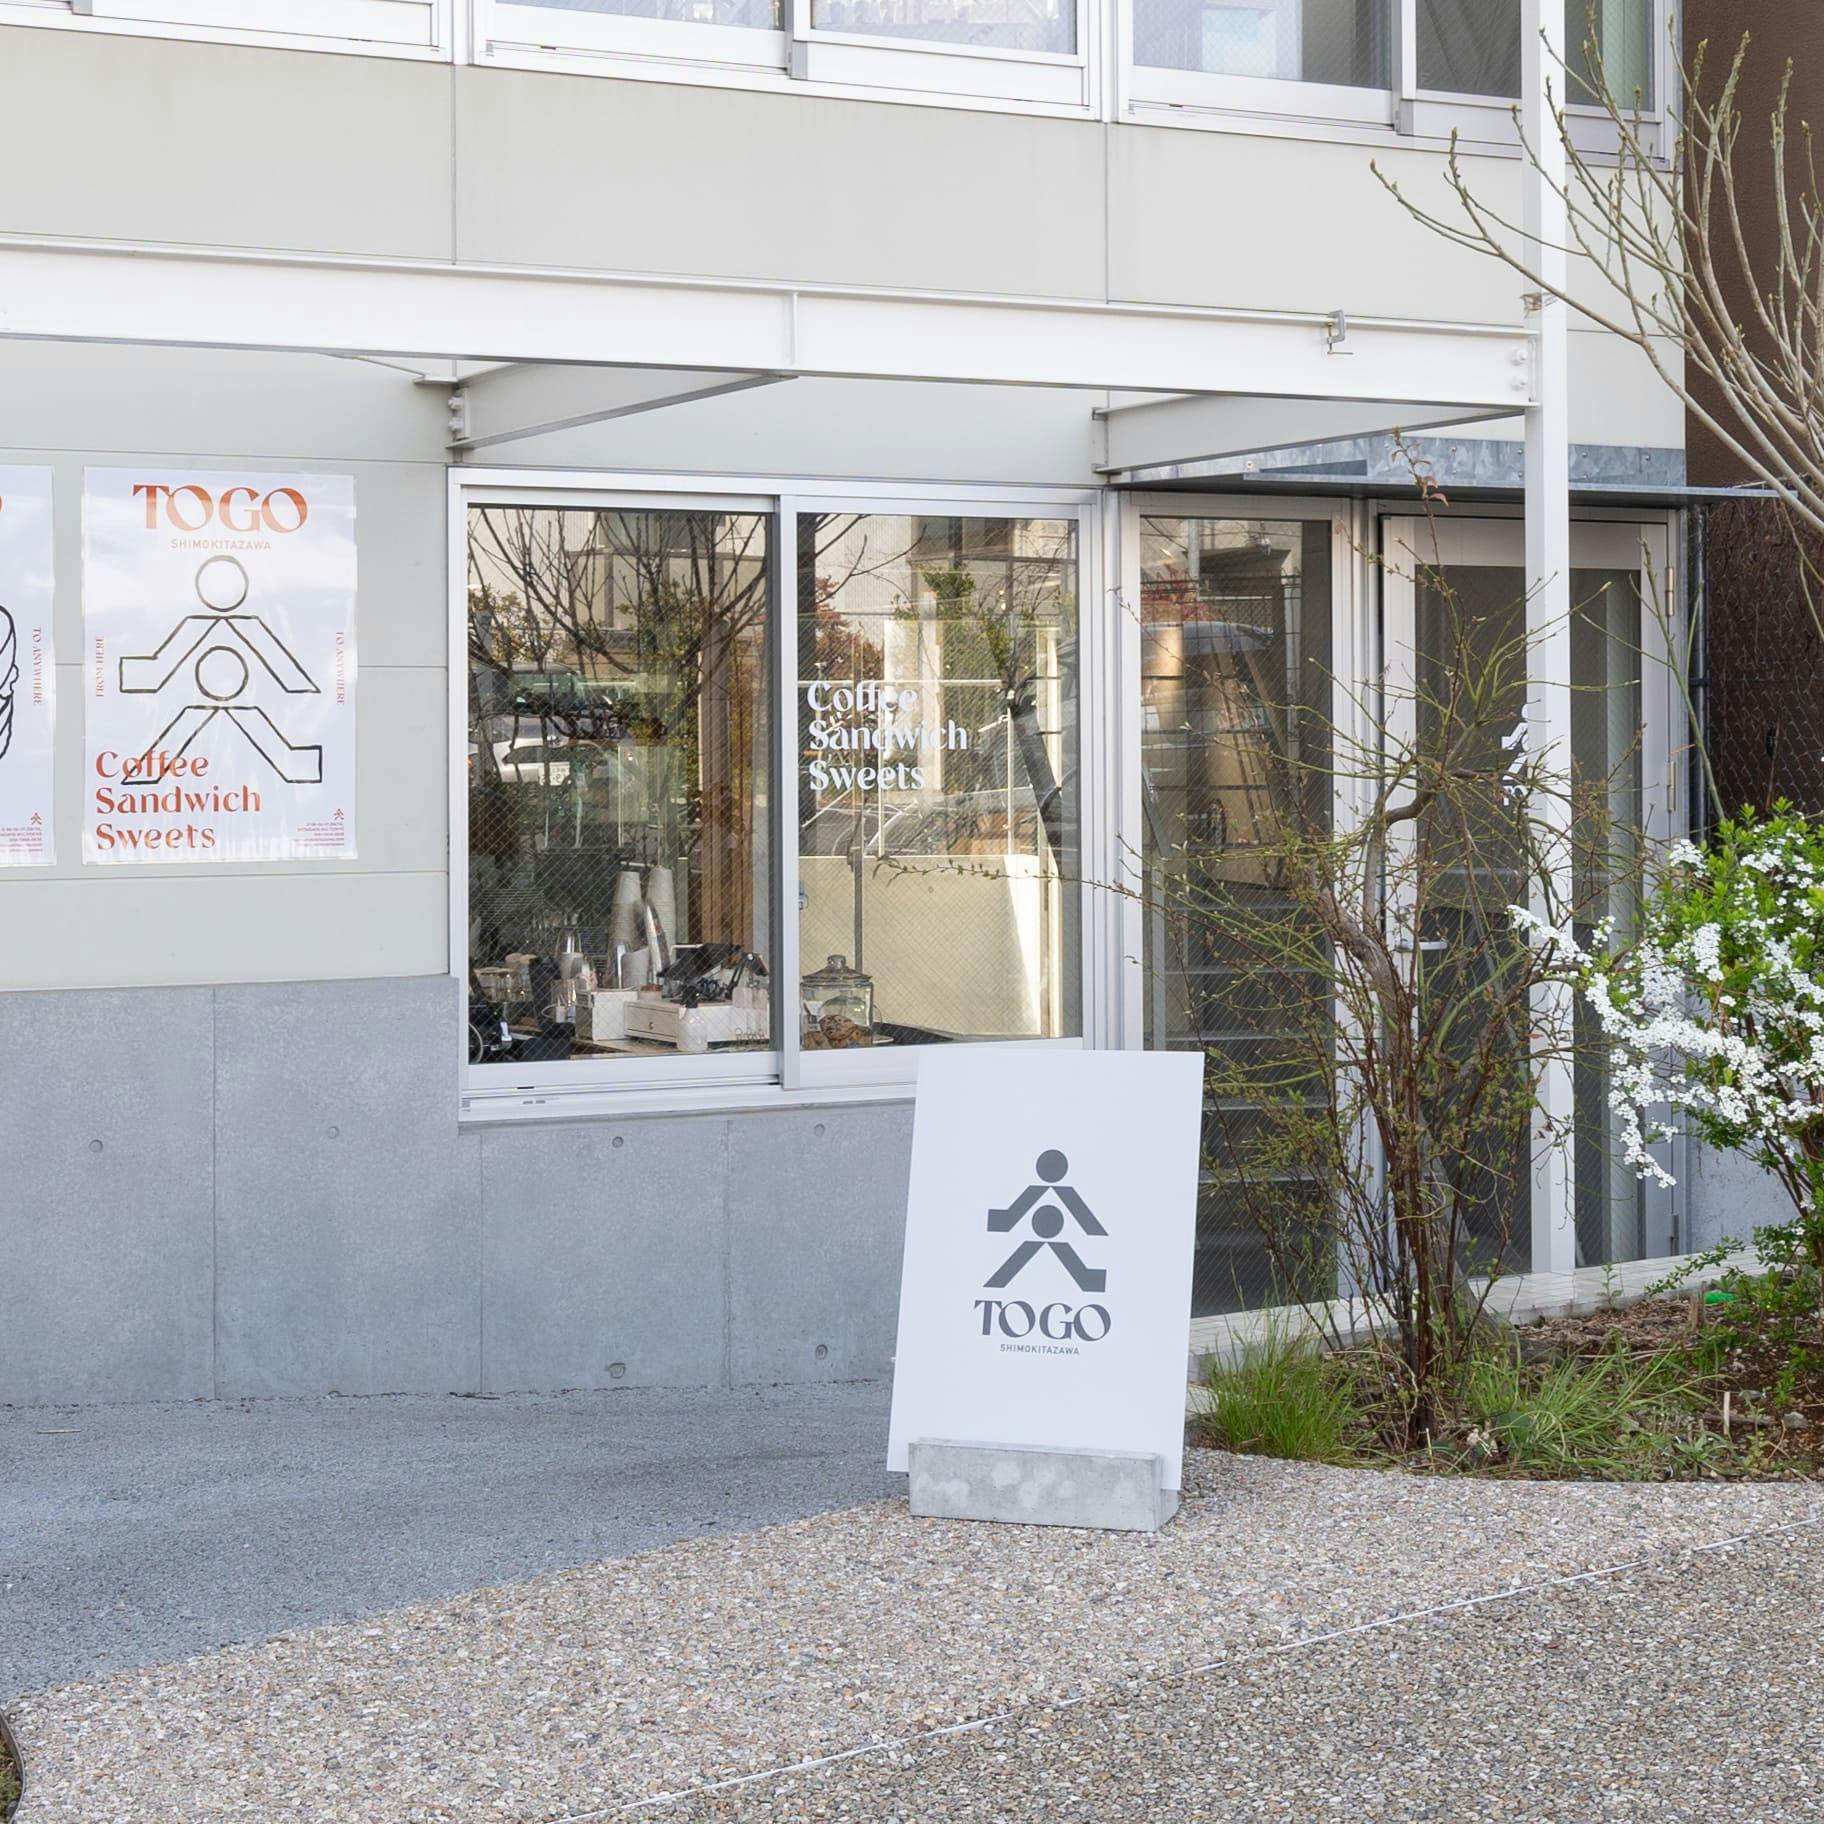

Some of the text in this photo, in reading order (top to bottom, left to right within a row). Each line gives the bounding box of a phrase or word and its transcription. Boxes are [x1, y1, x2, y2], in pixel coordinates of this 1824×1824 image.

[171, 538, 272, 551] SHIMOKITAZAWA
[95, 666, 105, 698] FROM
[807, 681, 918, 712] Coffee
[808, 719, 968, 750] Sandwich
[96, 750, 209, 778] Coffee
[808, 760, 926, 791] Sweets
[96, 785, 261, 814] Sandwich
[96, 823, 216, 849] Sweets
[1000, 1343, 1080, 1355] SHIMOKITAZAWA
